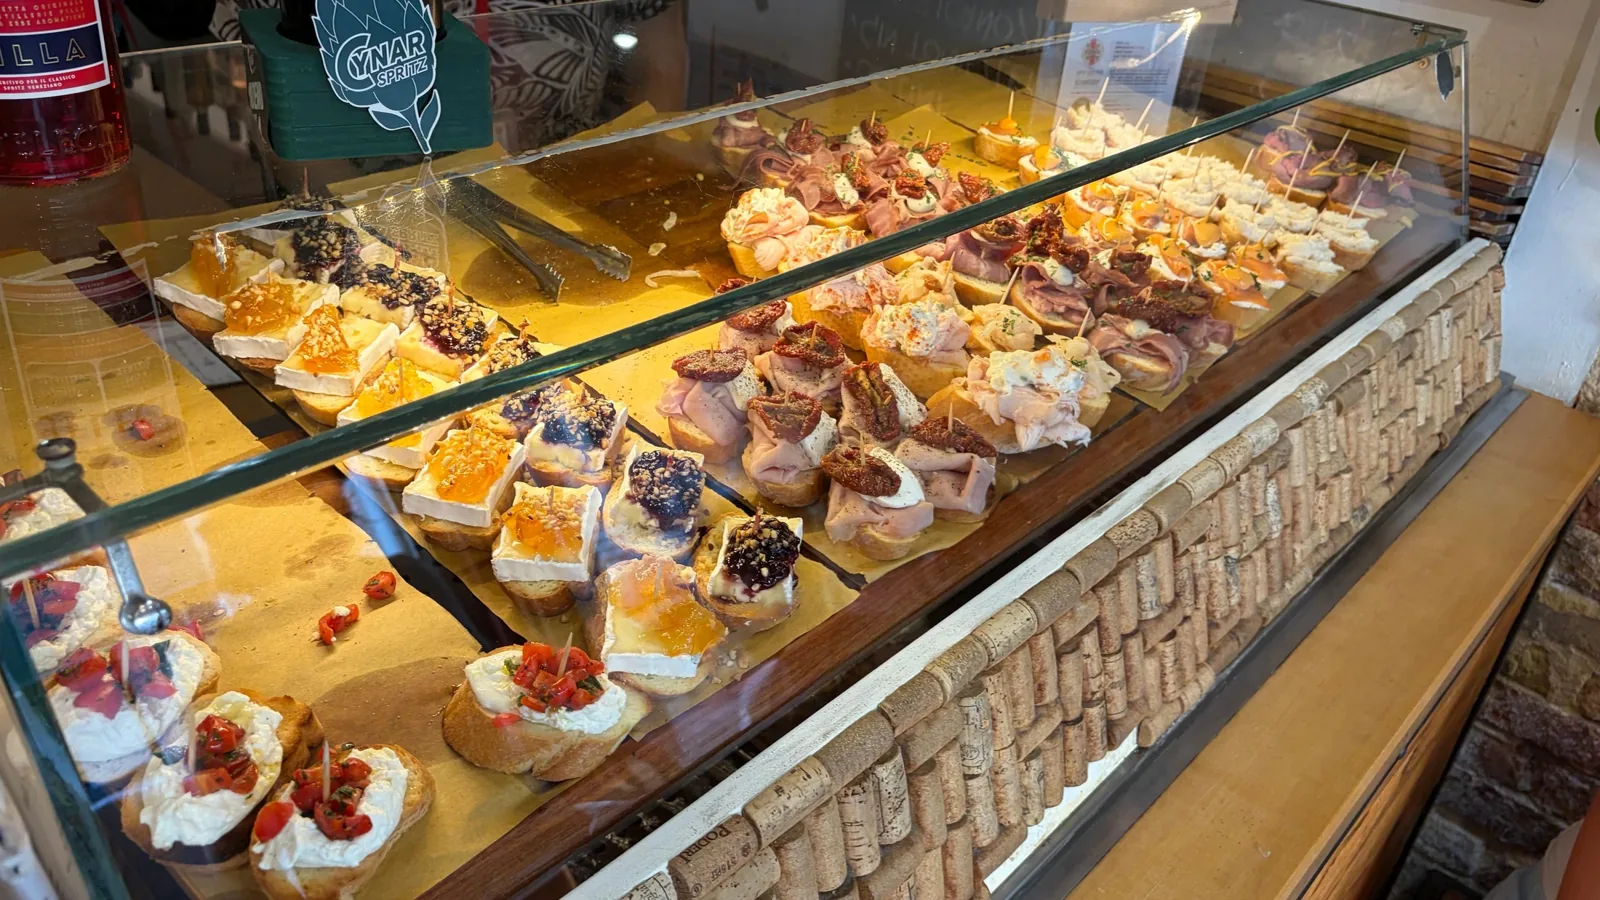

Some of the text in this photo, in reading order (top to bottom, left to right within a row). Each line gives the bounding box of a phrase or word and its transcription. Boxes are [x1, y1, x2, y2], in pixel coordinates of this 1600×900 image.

[36, 13, 86, 25] AROMATICHE
[335, 30, 426, 92] CYNAR
[377, 56, 428, 87] SPRITZ
[27, 82, 62, 90] VENEZIANO
[48, 74, 76, 83] CLASSICO
[679, 824, 732, 864] PODERI
